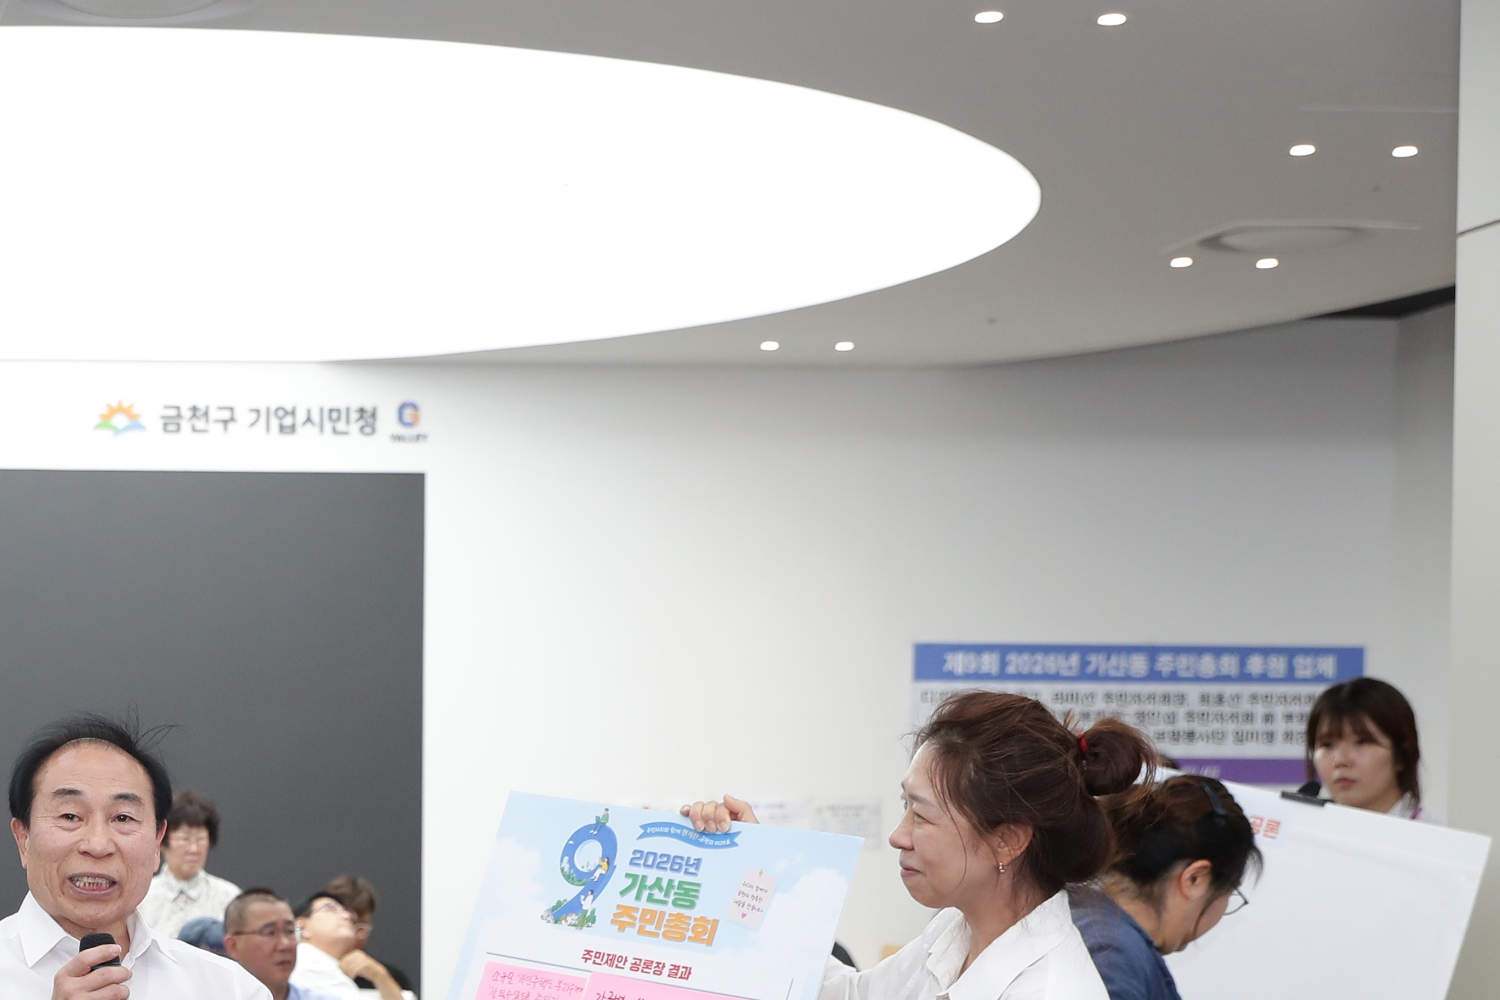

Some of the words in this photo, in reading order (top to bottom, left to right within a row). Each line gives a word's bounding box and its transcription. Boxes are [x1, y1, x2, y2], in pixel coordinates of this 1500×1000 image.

[160, 404, 238, 435] 금천구
[248, 404, 379, 436] 기업시민청
[942, 651, 1000, 676] 제9회
[1004, 651, 1081, 677] 2026년
[1085, 652, 1149, 678] 가산동
[1154, 652, 1241, 679] 주민총회
[1244, 653, 1288, 679] 후원
[1293, 654, 1338, 679] 업체
[628, 849, 703, 877] 2026년
[618, 872, 703, 911] 가산동
[610, 903, 719, 947] 주민총회
[581, 949, 628, 970] 주민제안
[630, 957, 666, 975] 공론장
[668, 963, 693, 982] 결과
